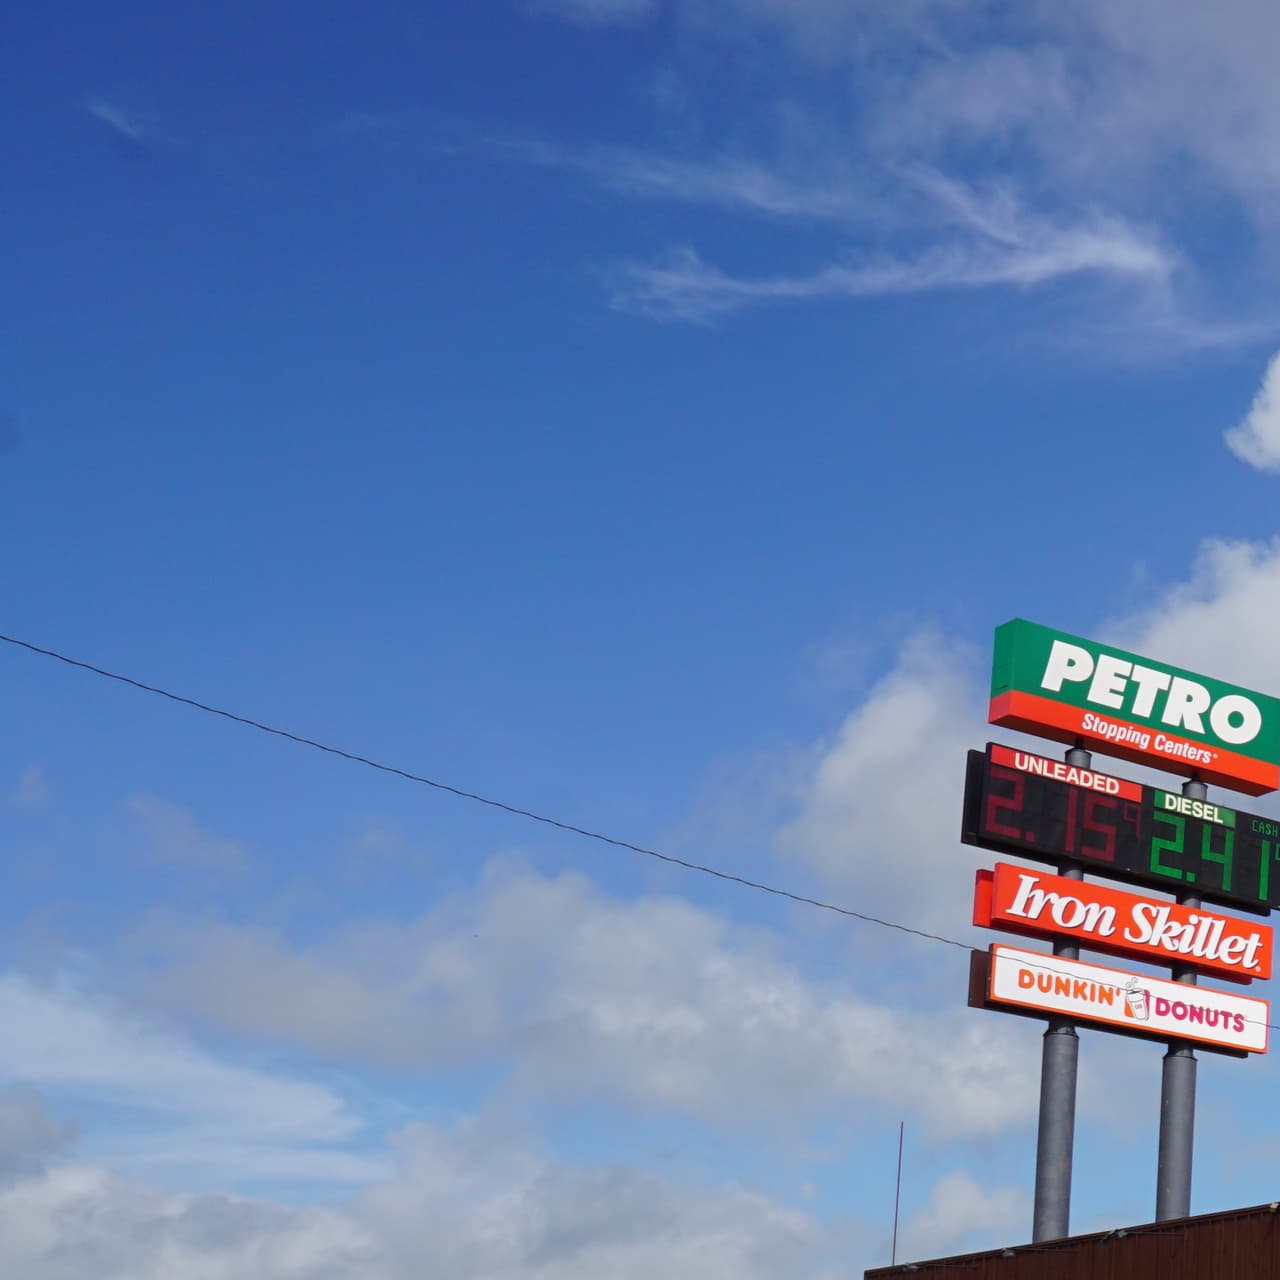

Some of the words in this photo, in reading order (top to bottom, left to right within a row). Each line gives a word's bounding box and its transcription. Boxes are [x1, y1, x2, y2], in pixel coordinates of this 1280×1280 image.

[1041, 639, 1262, 745] PETRO
[1082, 713, 1150, 750] Stopping
[1154, 734, 1214, 765] Centers
[1014, 752, 1120, 796] UNLEADED
[1164, 793, 1224, 824] DIESEL
[1251, 819, 1279, 837] CASH
[1005, 873, 1116, 937] Iron
[1124, 901, 1263, 969] Skillet
[1017, 968, 1121, 1007] DUNKIN'
[1155, 996, 1246, 1033] DONUTS
